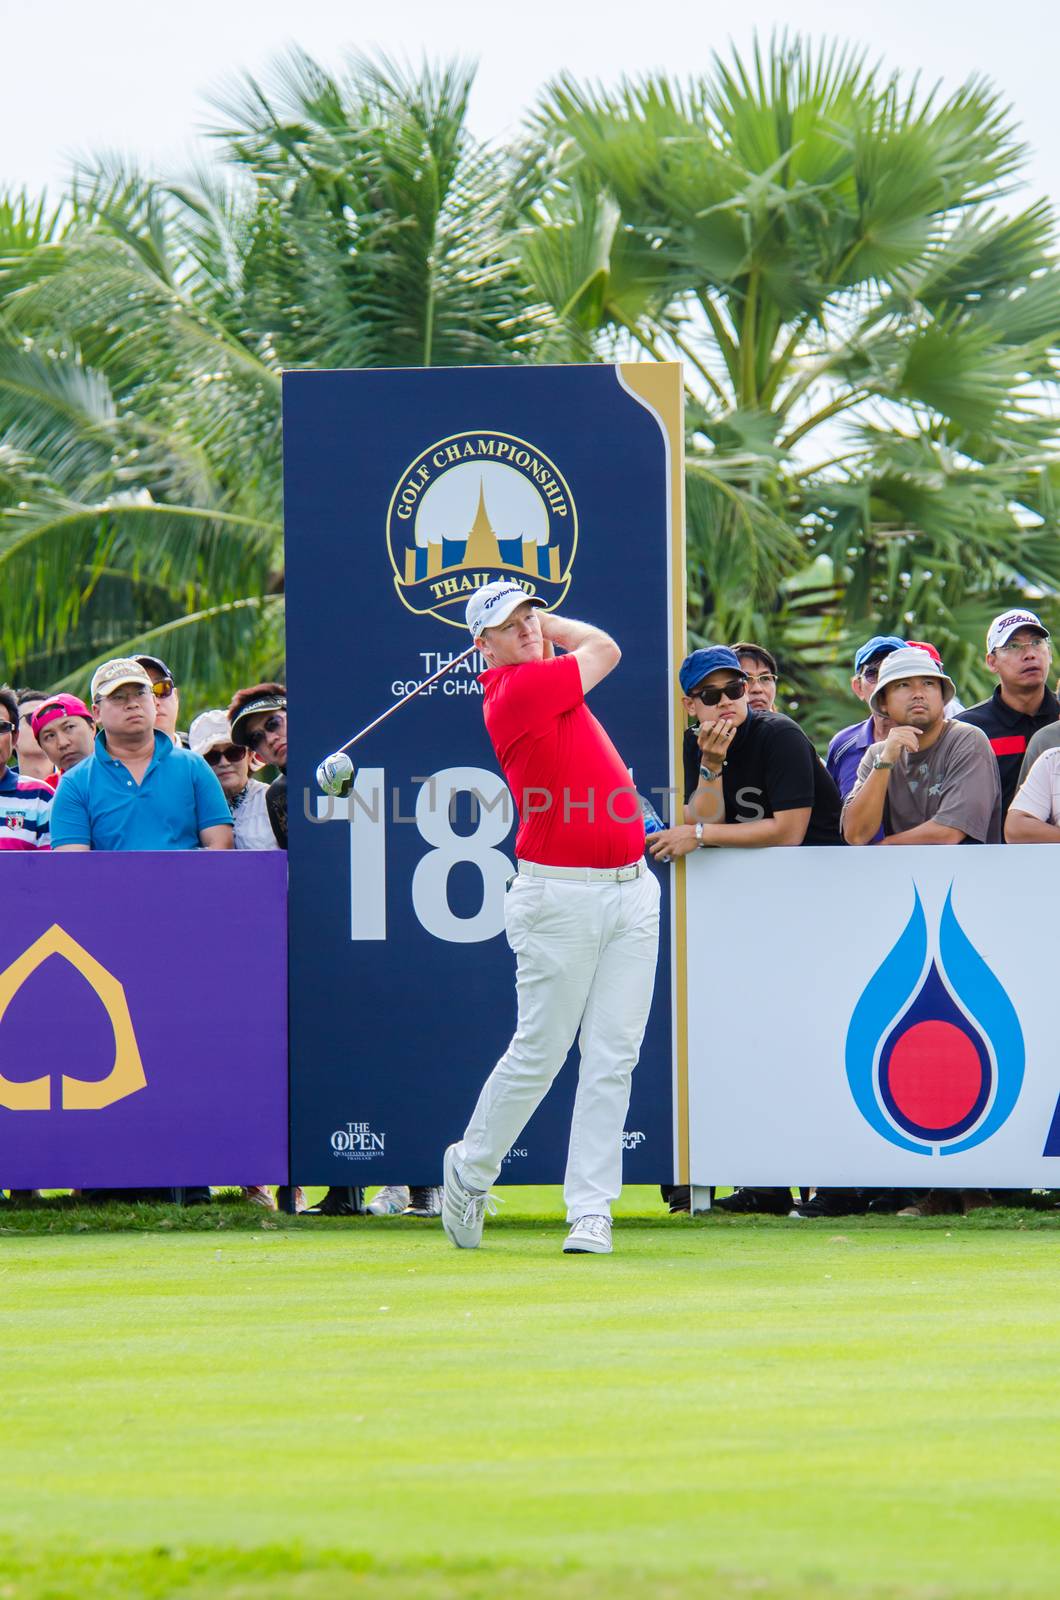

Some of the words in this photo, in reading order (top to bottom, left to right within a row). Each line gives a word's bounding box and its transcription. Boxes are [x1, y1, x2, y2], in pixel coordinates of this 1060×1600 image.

[397, 464, 431, 519] GOLF
[432, 439, 568, 517] CHAMPIONSHIP
[420, 652, 488, 674] THAIL
[391, 680, 439, 696] GOLF
[316, 767, 516, 944] 18
[346, 1122, 370, 1133] THE
[331, 1130, 386, 1151] OPEN
